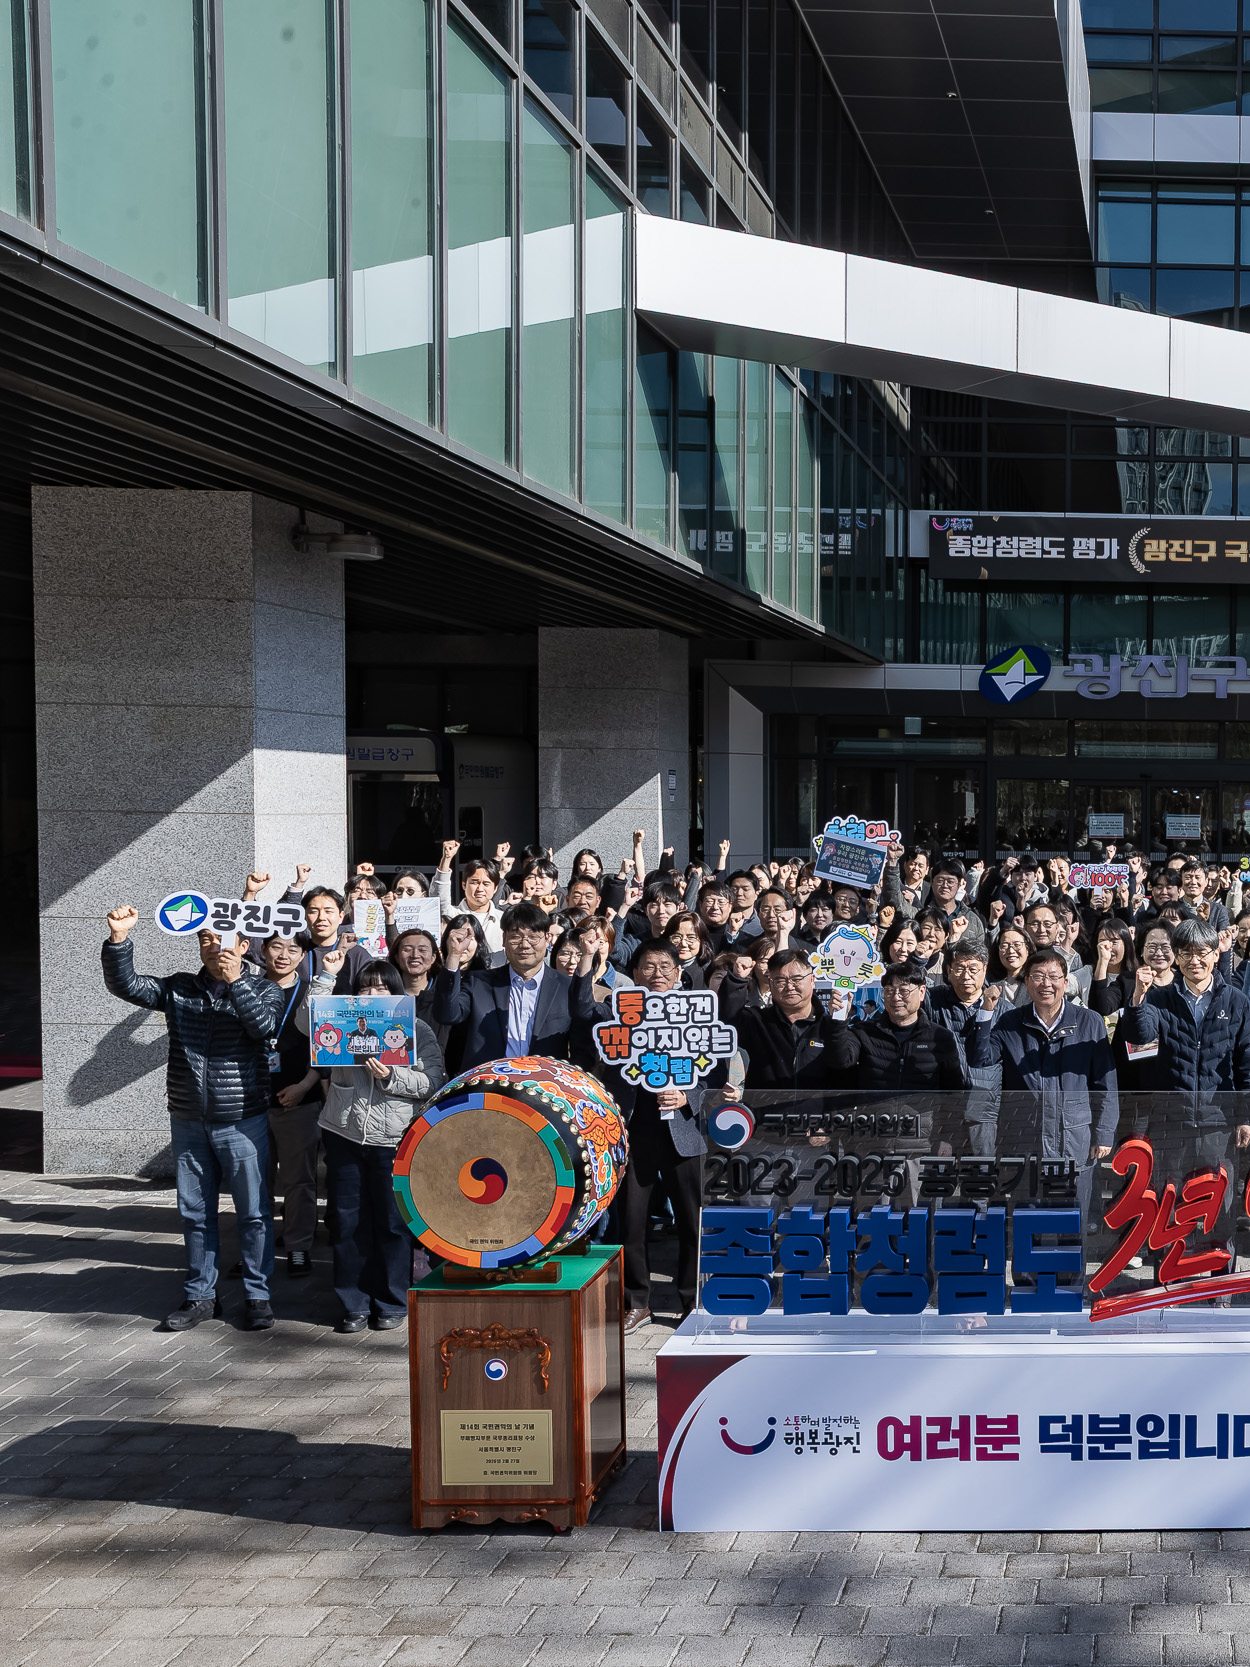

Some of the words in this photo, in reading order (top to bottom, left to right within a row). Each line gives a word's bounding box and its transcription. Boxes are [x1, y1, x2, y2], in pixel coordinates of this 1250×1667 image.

[948, 535, 1066, 559] 종합청렴도
[1072, 538, 1120, 560] 평가
[1143, 539, 1217, 563] 광진구
[211, 902, 302, 935] 광진구
[337, 1010, 374, 1018] 국민권익의
[376, 1010, 385, 1018] 날
[619, 993, 711, 1025] 중요한건
[600, 1027, 679, 1058] 꺾이지
[686, 1027, 731, 1052] 않는
[641, 1053, 692, 1086] 청렴
[761, 1113, 921, 1139] 국민권익위원회
[704, 1153, 909, 1198] 2023-2025
[918, 1156, 1080, 1198] 공공기관
[701, 1205, 1084, 1316] 종합청렴도
[1088, 1136, 1233, 1293] 3년
[783, 1415, 821, 1428] 소통하며
[822, 1415, 862, 1430] 발전하는
[876, 1414, 1021, 1462] 여러분
[783, 1430, 862, 1456] 행복광진
